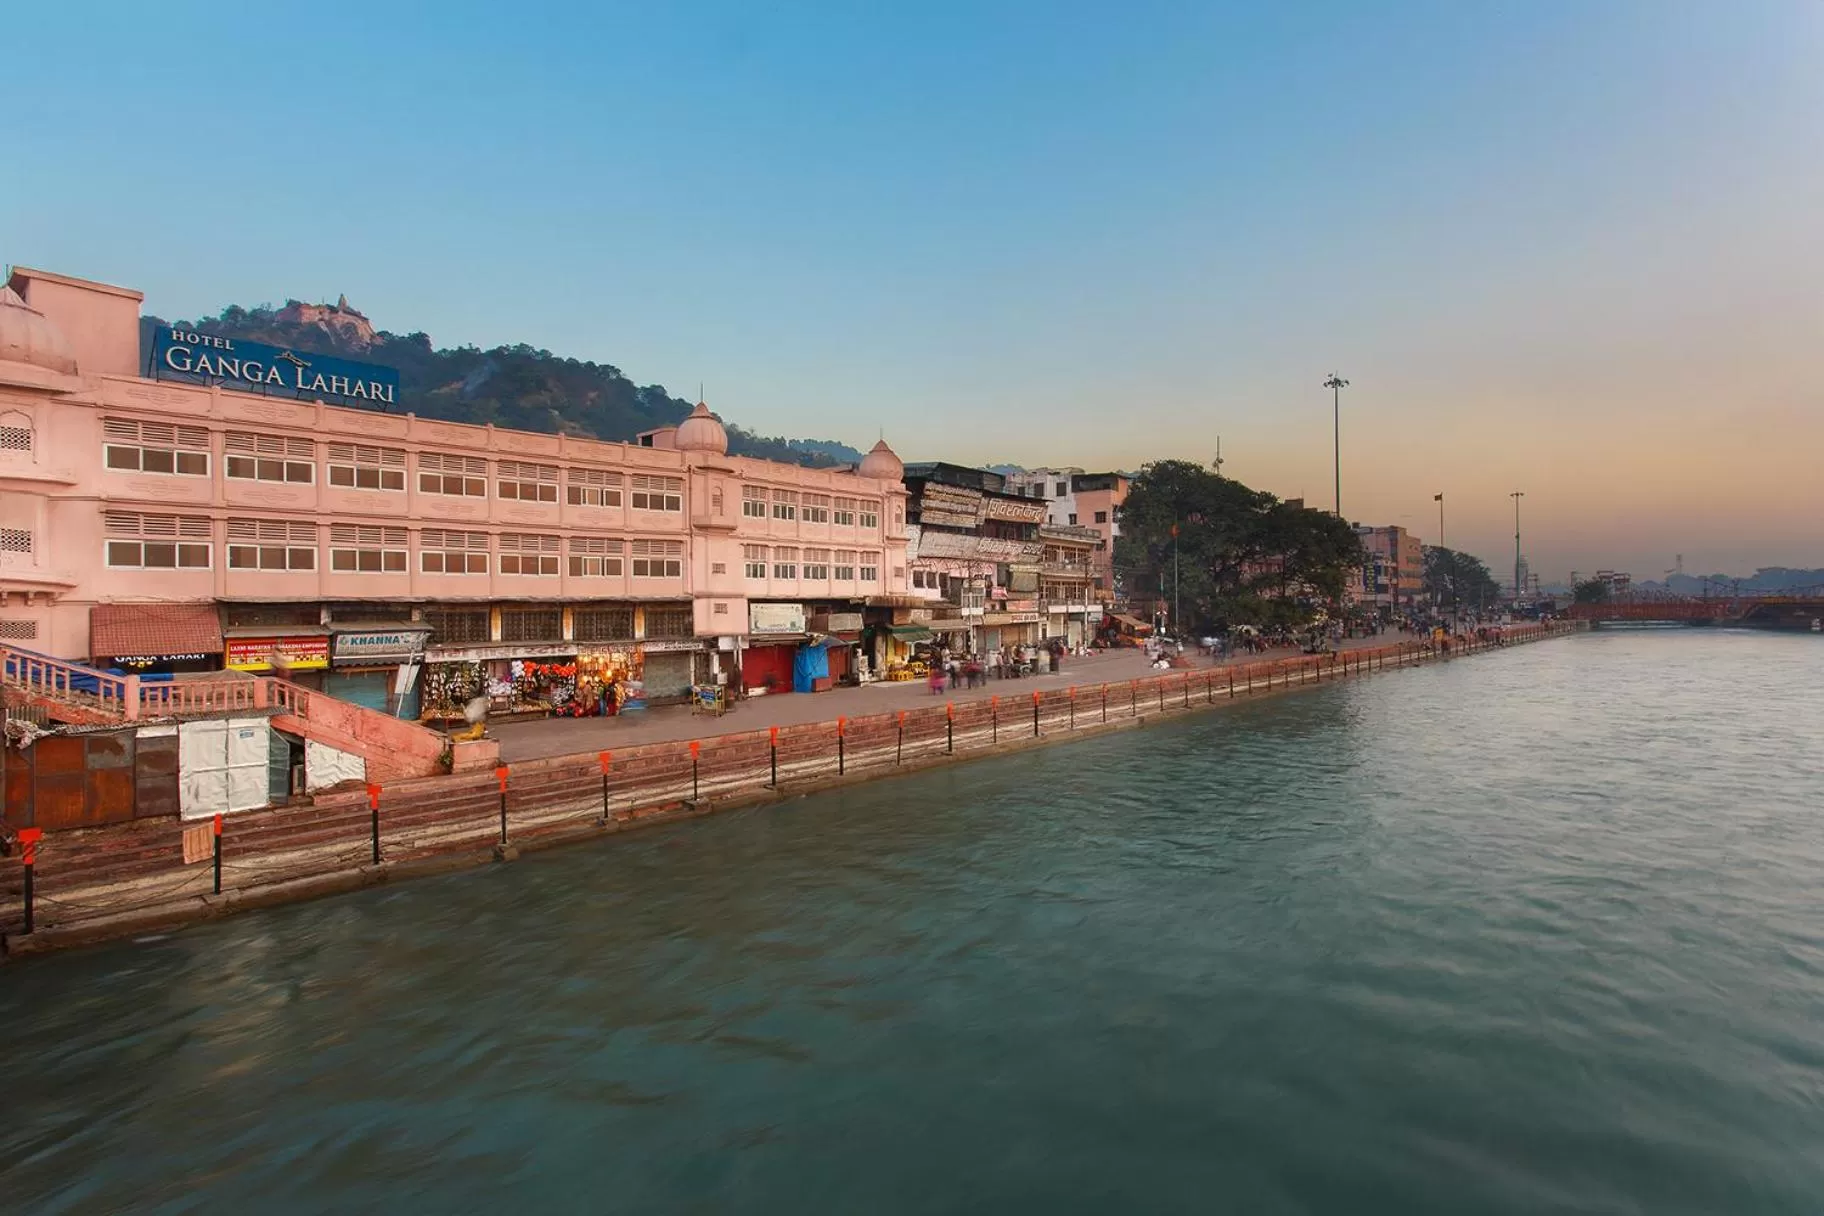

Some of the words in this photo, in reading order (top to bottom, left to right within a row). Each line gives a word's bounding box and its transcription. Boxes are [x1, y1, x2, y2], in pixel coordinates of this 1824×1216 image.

[172, 329, 235, 351] HOTEL
[165, 346, 286, 387] GANGA
[296, 366, 394, 403] LAHARI
